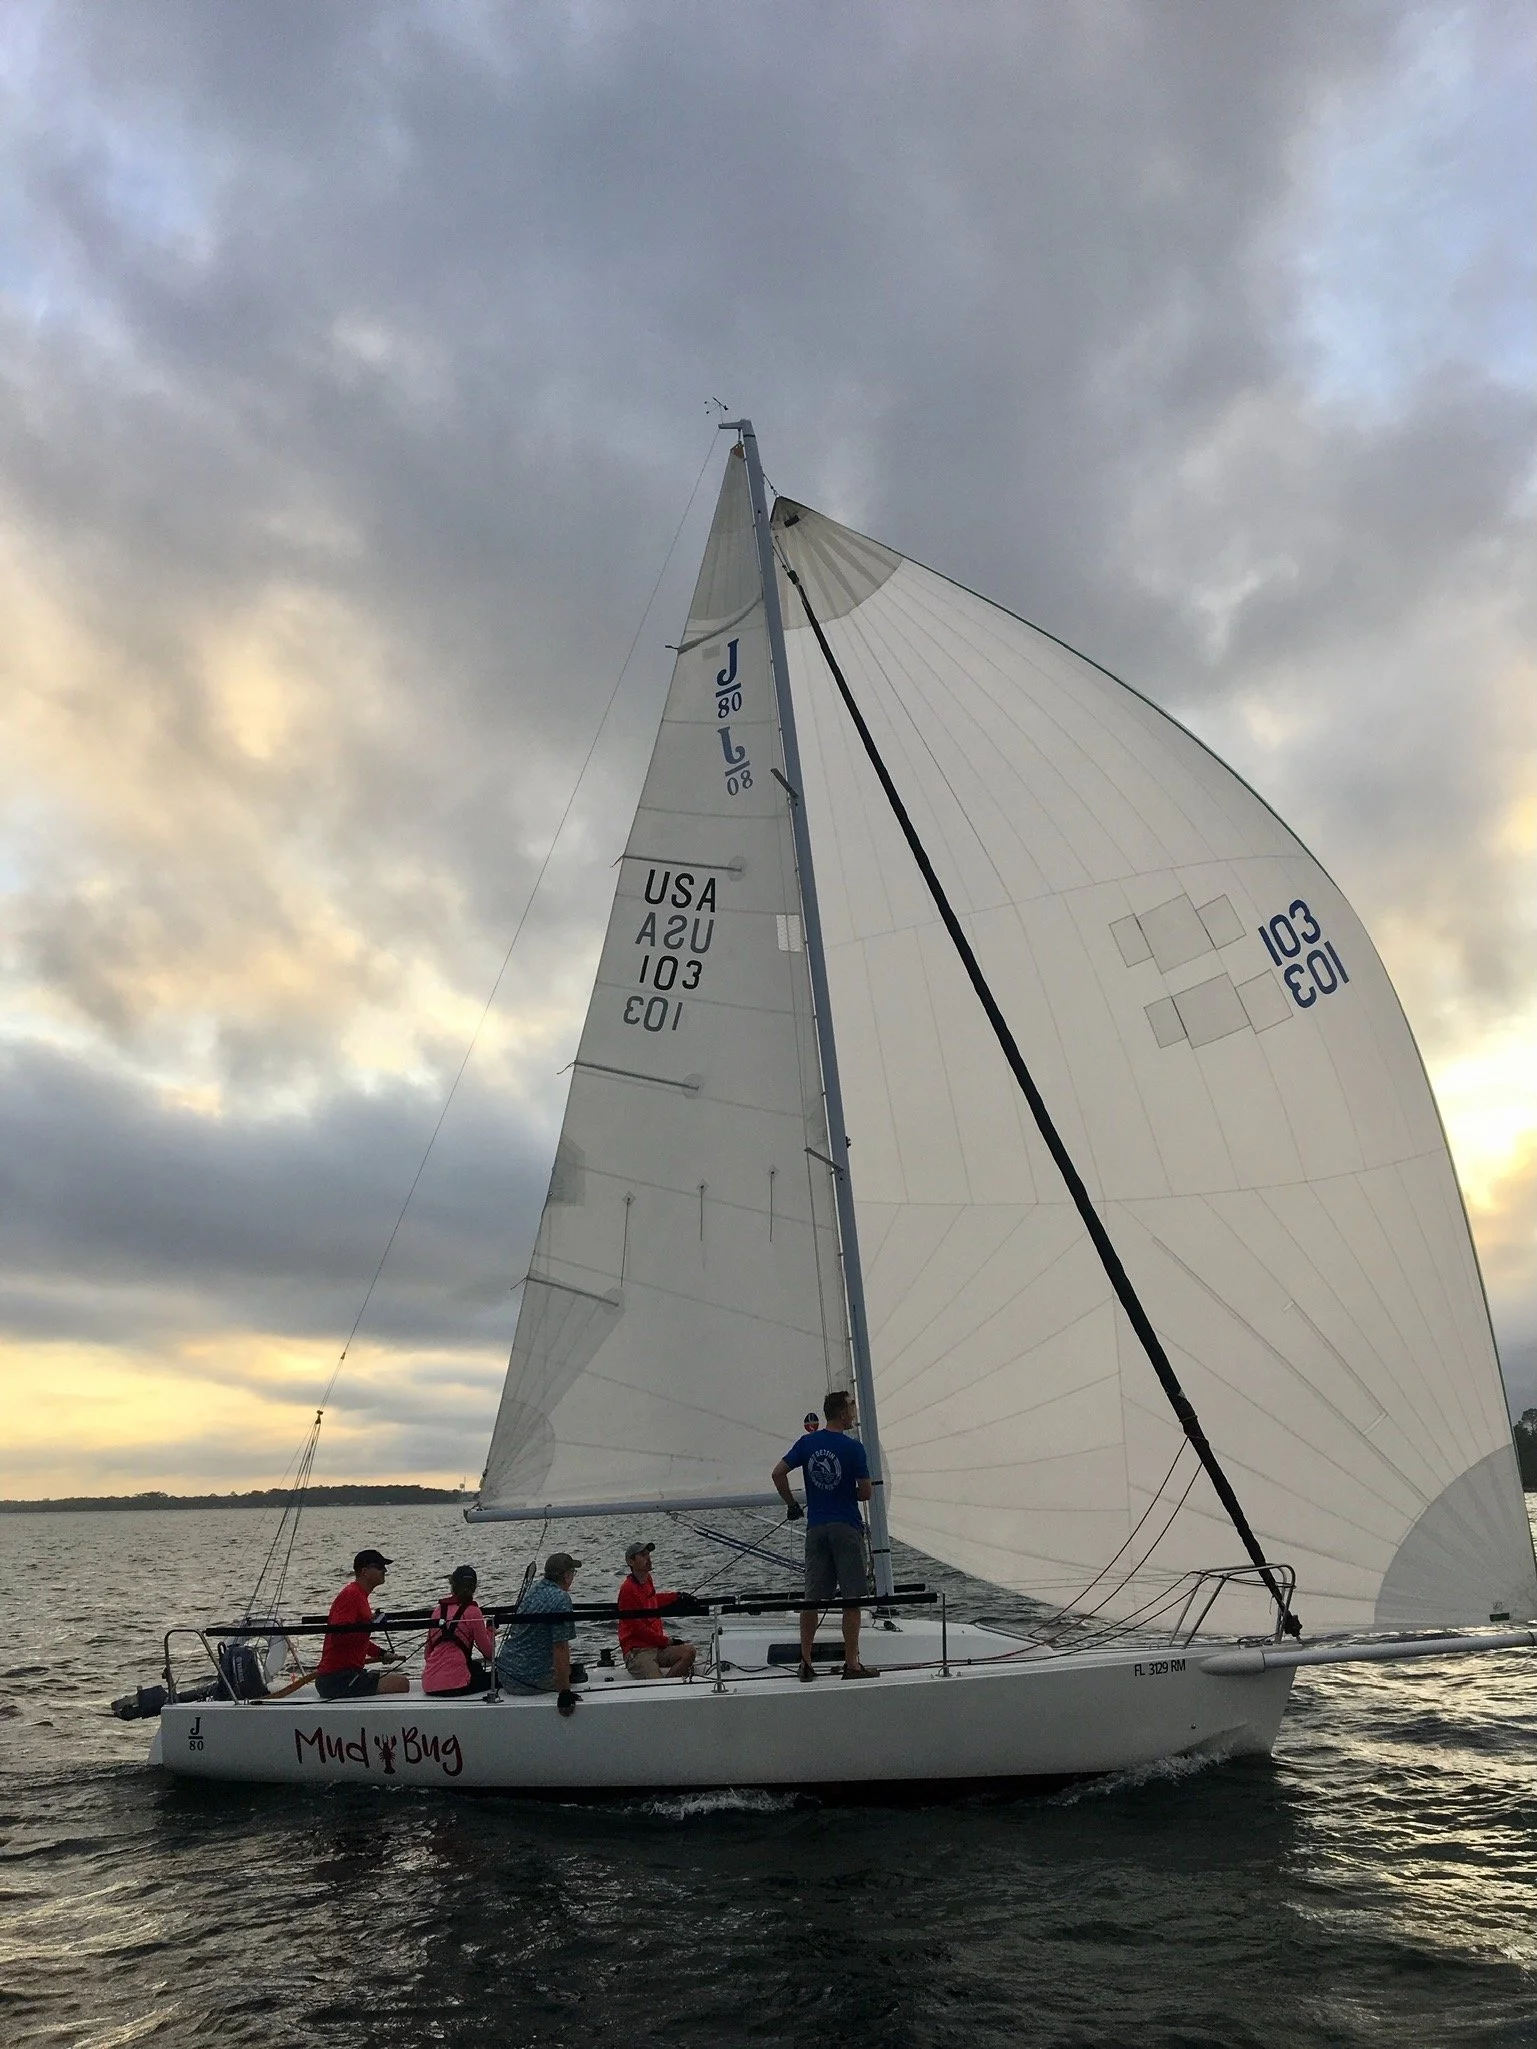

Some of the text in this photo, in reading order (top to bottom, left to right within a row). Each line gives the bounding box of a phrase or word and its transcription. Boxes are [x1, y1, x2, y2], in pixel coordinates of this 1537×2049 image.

[717, 638, 739, 686] J
[717, 691, 742, 719] 80
[644, 869, 716, 913] USA
[1258, 899, 1321, 967] 103
[639, 955, 703, 991] 103
[1134, 1659, 1186, 1676] FL 3129 RM
[189, 1717, 201, 1736] J
[188, 1740, 204, 1751] 80
[294, 1726, 464, 1777] Mud Bug
